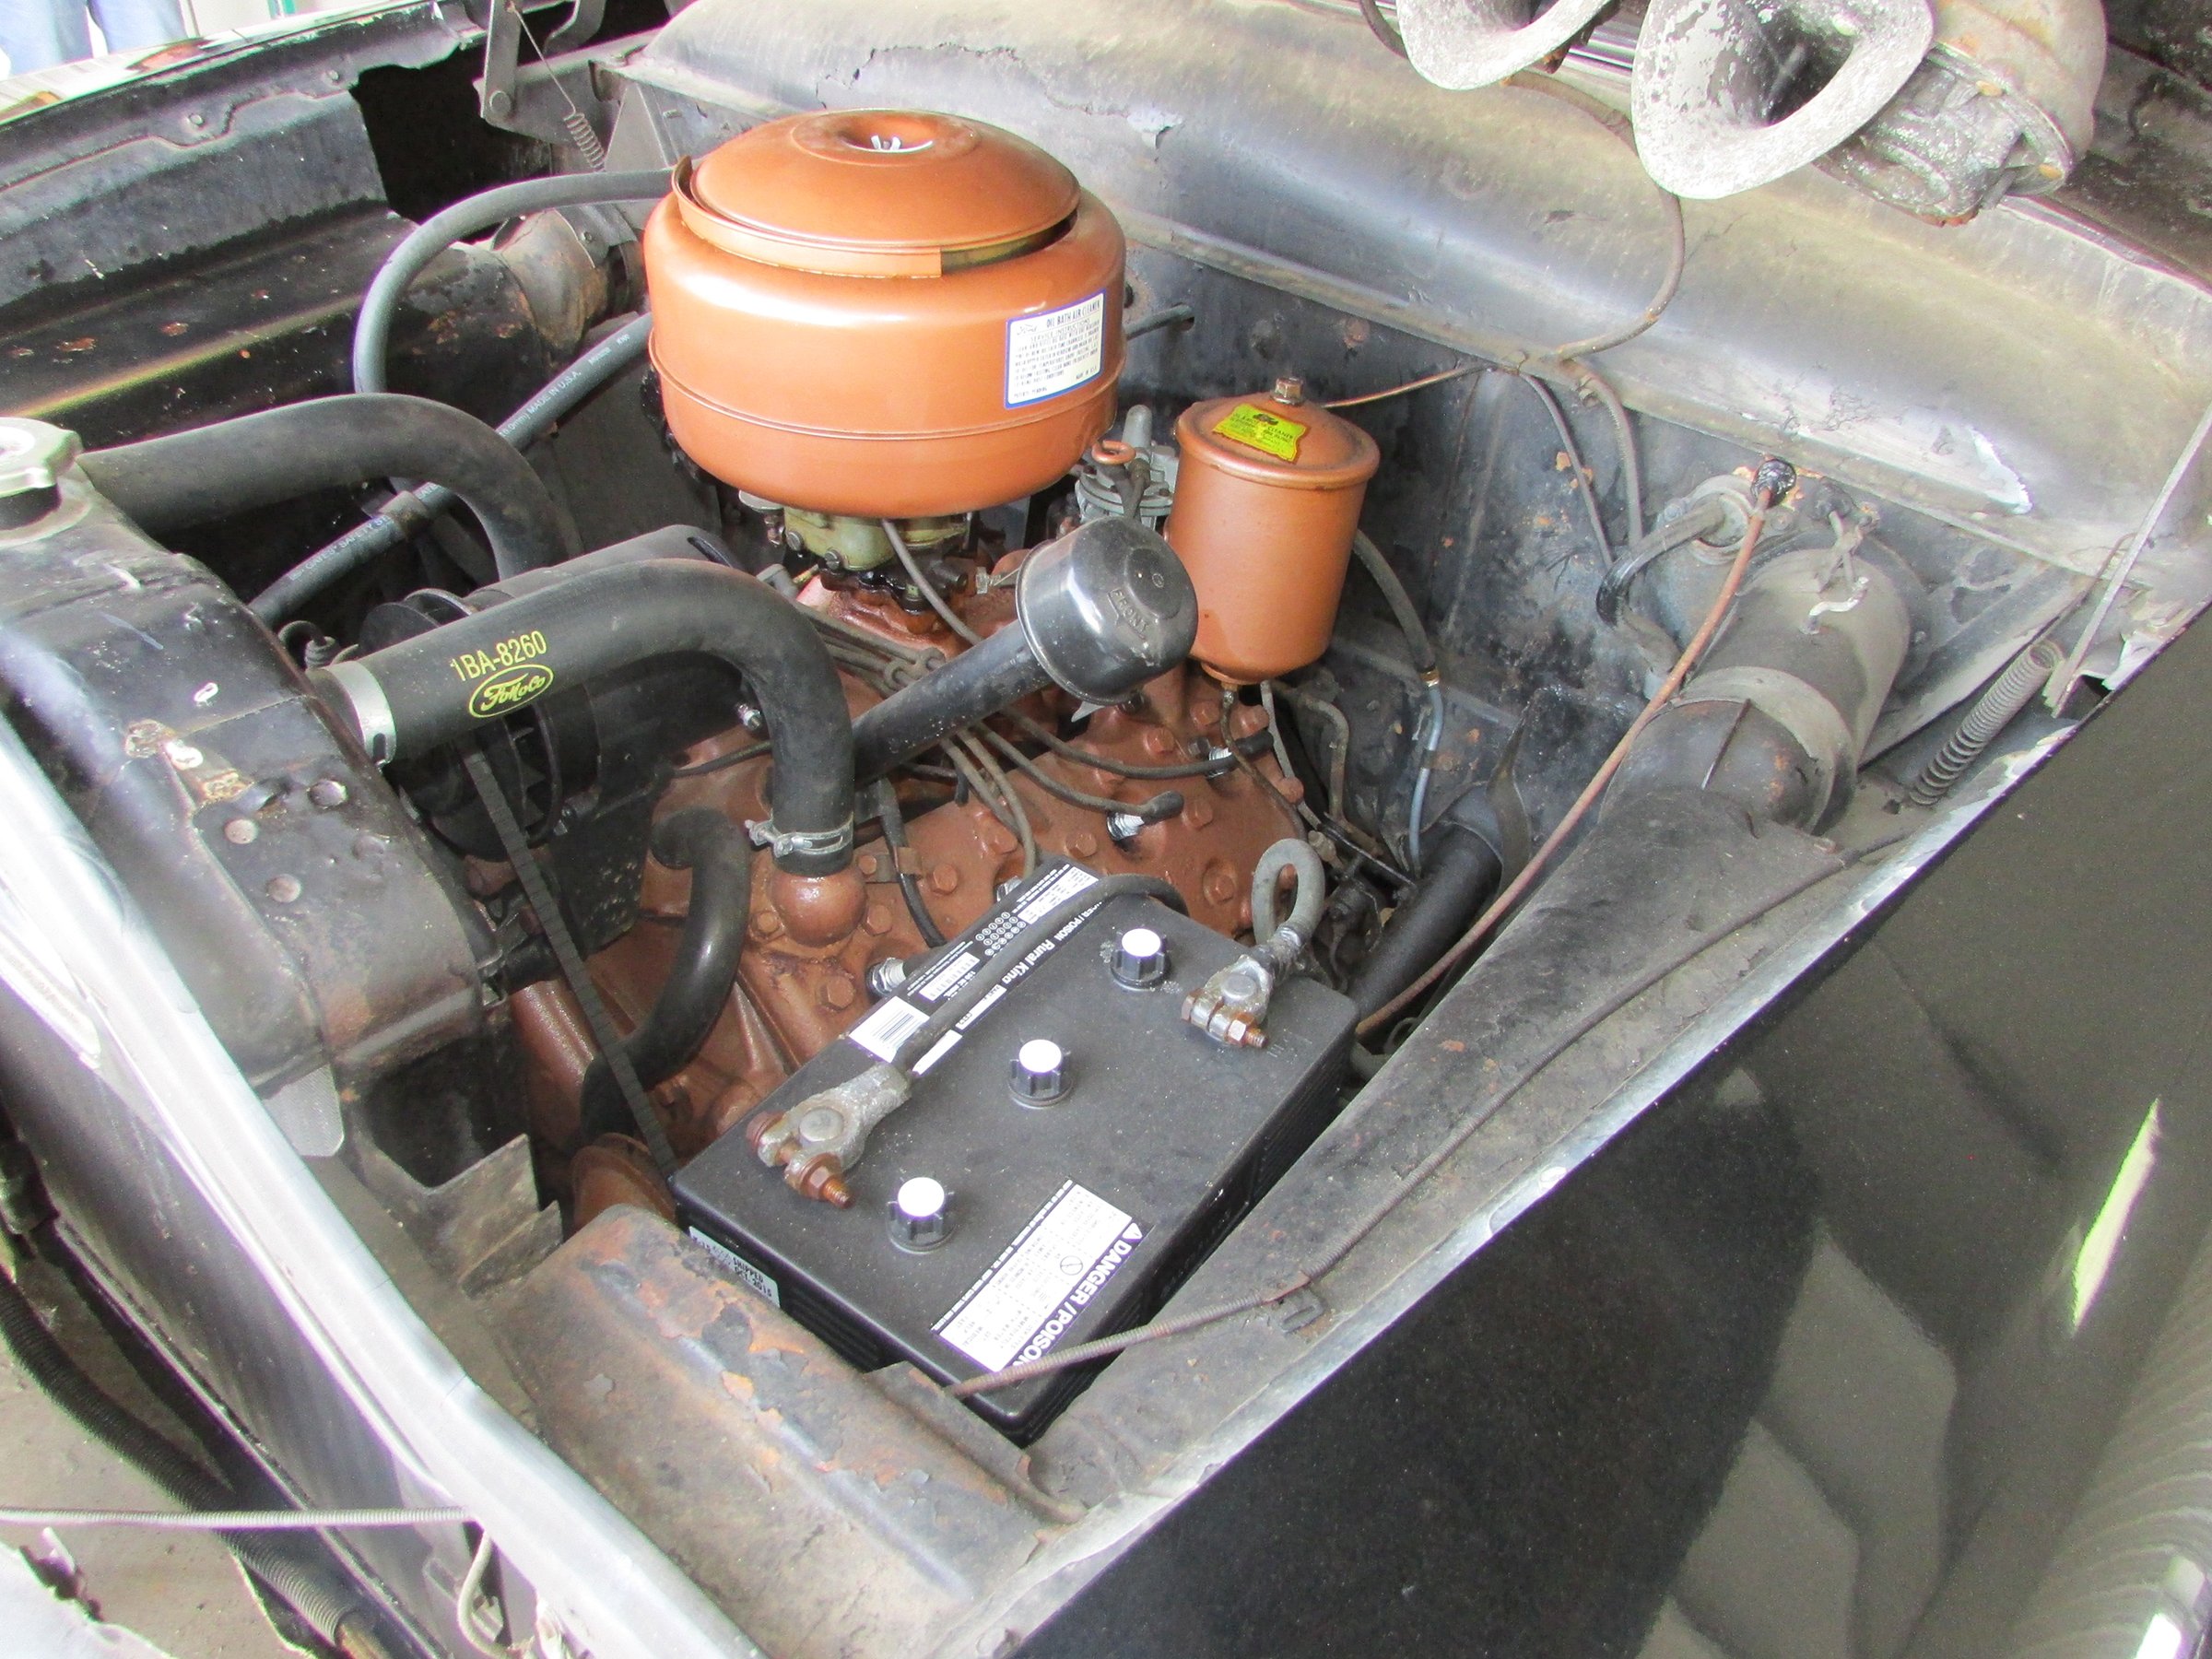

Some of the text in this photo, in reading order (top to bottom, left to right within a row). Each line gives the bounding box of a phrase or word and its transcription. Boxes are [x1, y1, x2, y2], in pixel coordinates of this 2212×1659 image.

[1046, 317, 1055, 328] OIL
[1057, 312, 1072, 325] BATH
[1072, 308, 1082, 320] AIR
[526, 394, 552, 415] MADE
[548, 387, 559, 397] IN
[560, 370, 582, 389] U.S.A.
[1110, 590, 1149, 633] FRONT
[449, 630, 547, 682] 1BA-8260
[480, 672, 546, 712] FoMoCo
[1024, 938, 1055, 967] Rural
[733, 1256, 764, 1284] SHIPPED
[1070, 1239, 1133, 1306] DANGER
